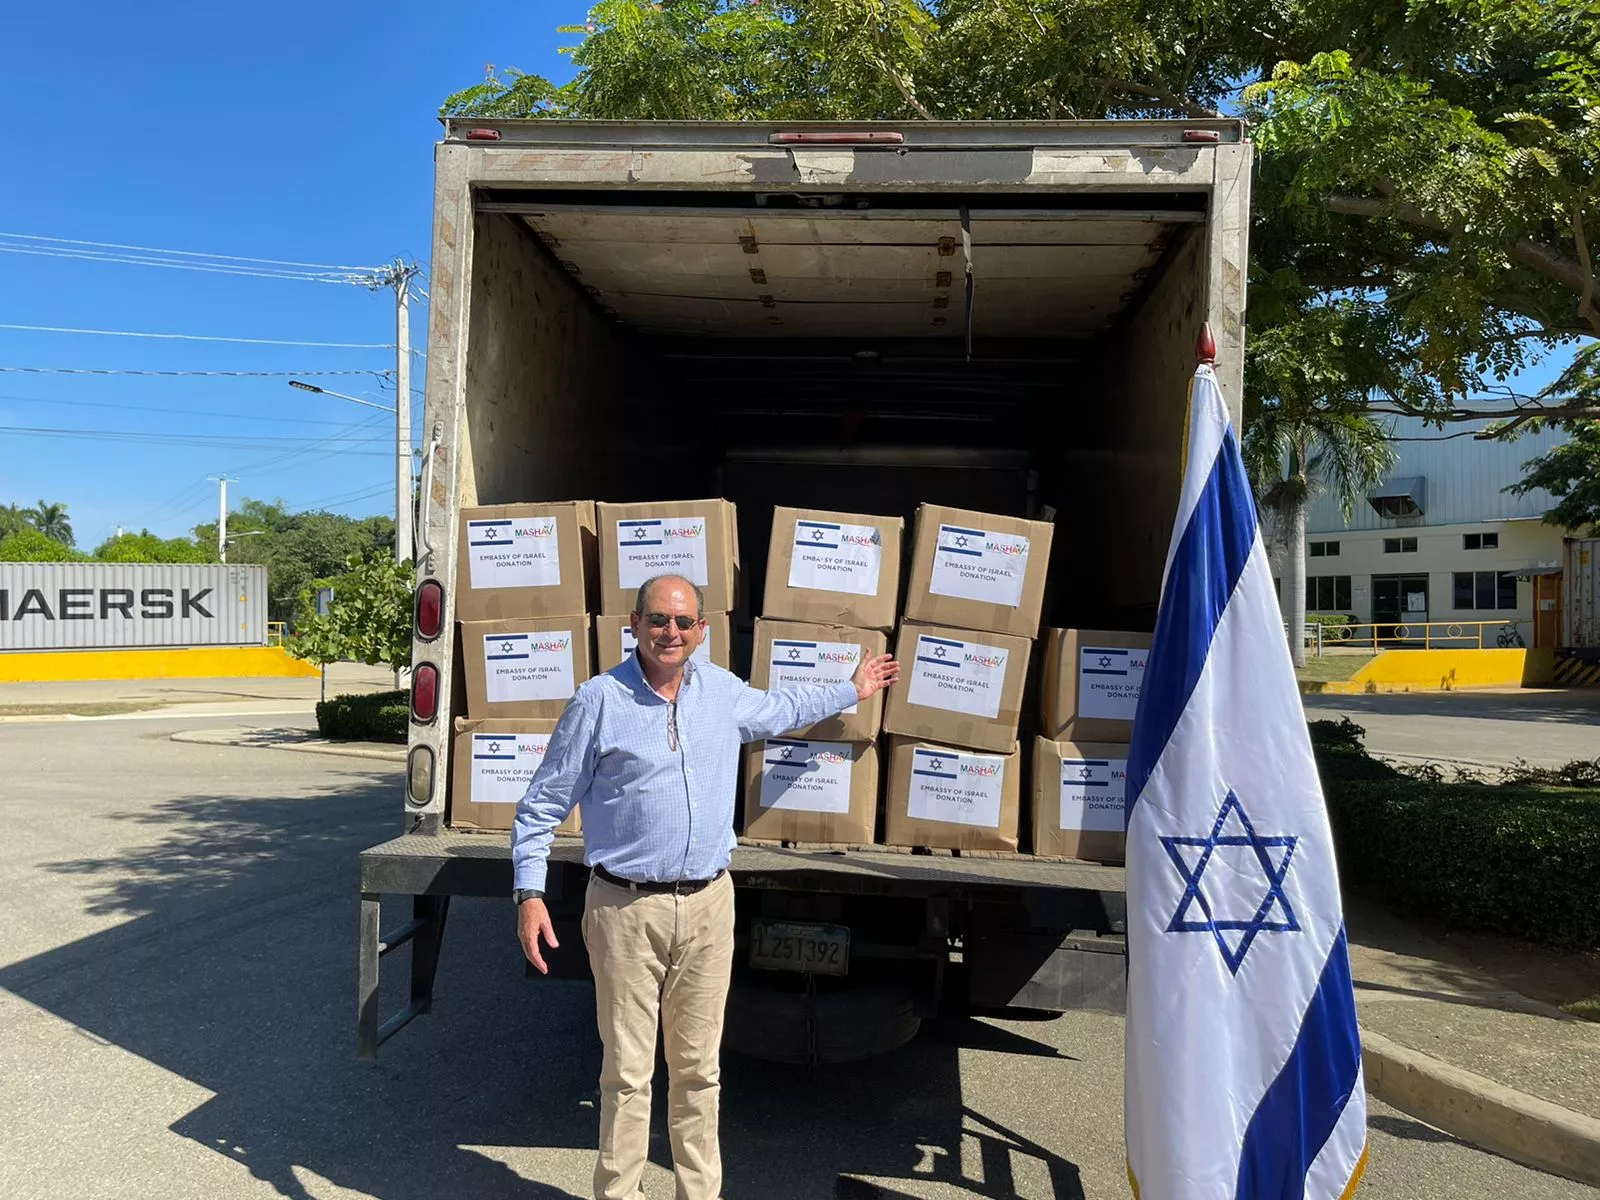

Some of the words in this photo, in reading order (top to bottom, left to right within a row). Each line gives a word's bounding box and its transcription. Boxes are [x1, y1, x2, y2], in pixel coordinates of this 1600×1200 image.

[514, 525, 554, 538] MASHAV
[664, 525, 703, 538] MASHAV
[841, 534, 880, 546] MASHAV
[985, 542, 1026, 556] MASHAV
[802, 555, 832, 563] EMBASY
[845, 559, 868, 567] ISRAEL
[817, 564, 853, 572] DONATION
[945, 561, 976, 571] EMBASSY
[988, 568, 1012, 577] ISRAEL
[959, 571, 996, 582] DONATION
[0, 588, 215, 621] AERSK
[531, 638, 569, 652] MASHAV
[818, 651, 858, 664] MASHAV
[964, 653, 1005, 668] MASHAV
[496, 667, 526, 675] EMBASSY
[780, 675, 810, 683] EMBASSY
[922, 671, 954, 682] EMBASSY
[966, 679, 990, 689] ISRAEL
[937, 682, 974, 693] DONATION
[1090, 683, 1123, 691] EMBASSY
[517, 743, 548, 754] MASHA
[810, 750, 850, 764] MASHAV
[960, 764, 1001, 777] MASHAV
[772, 774, 802, 783] EMBASSY
[787, 783, 823, 791] DONATION
[920, 784, 952, 794] EMBASSY
[964, 790, 989, 798] ISRAEL
[936, 794, 973, 804] DONATION
